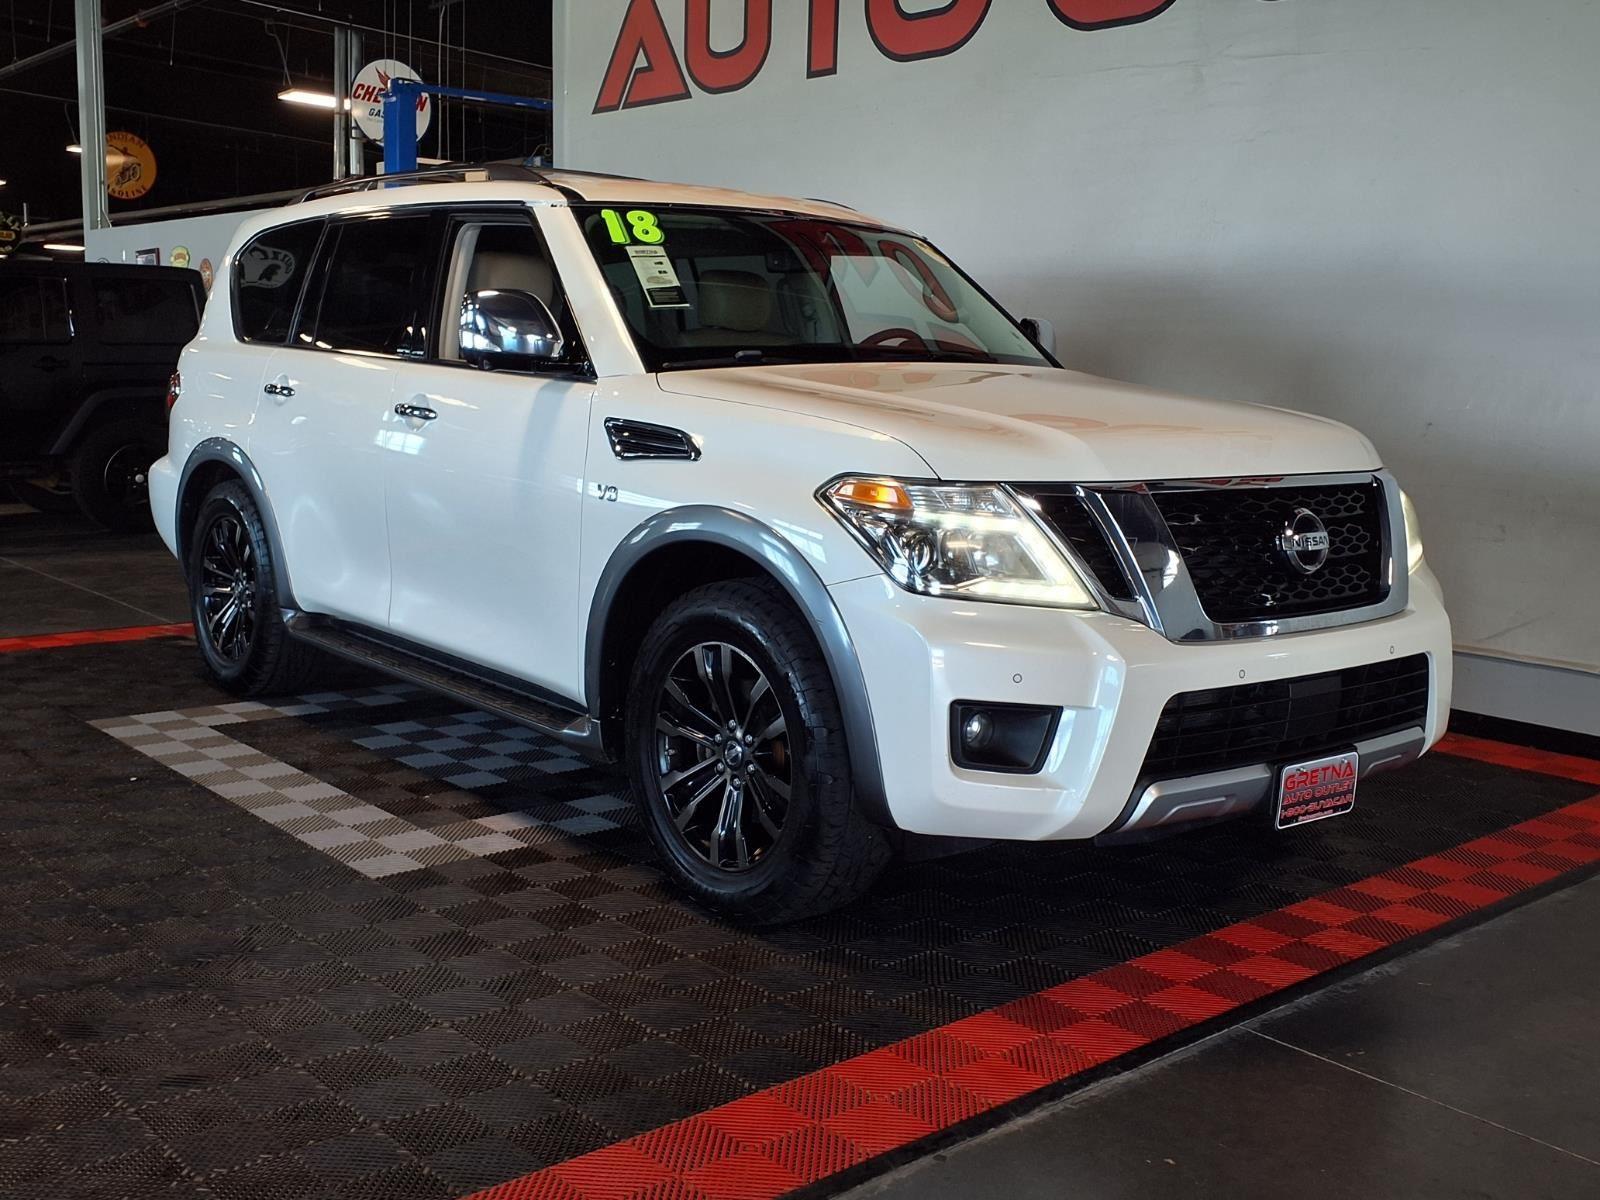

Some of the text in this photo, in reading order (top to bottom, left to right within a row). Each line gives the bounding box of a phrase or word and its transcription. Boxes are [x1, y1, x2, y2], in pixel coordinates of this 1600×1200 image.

[352, 83, 428, 111] CHEN
[107, 133, 144, 149] NDIAN
[601, 209, 665, 244] 18
[597, 483, 618, 502] V8
[1293, 534, 1328, 548] NISSAN
[1285, 761, 1354, 791] GRETNA
[1282, 781, 1353, 805] AUTO OUTLET
